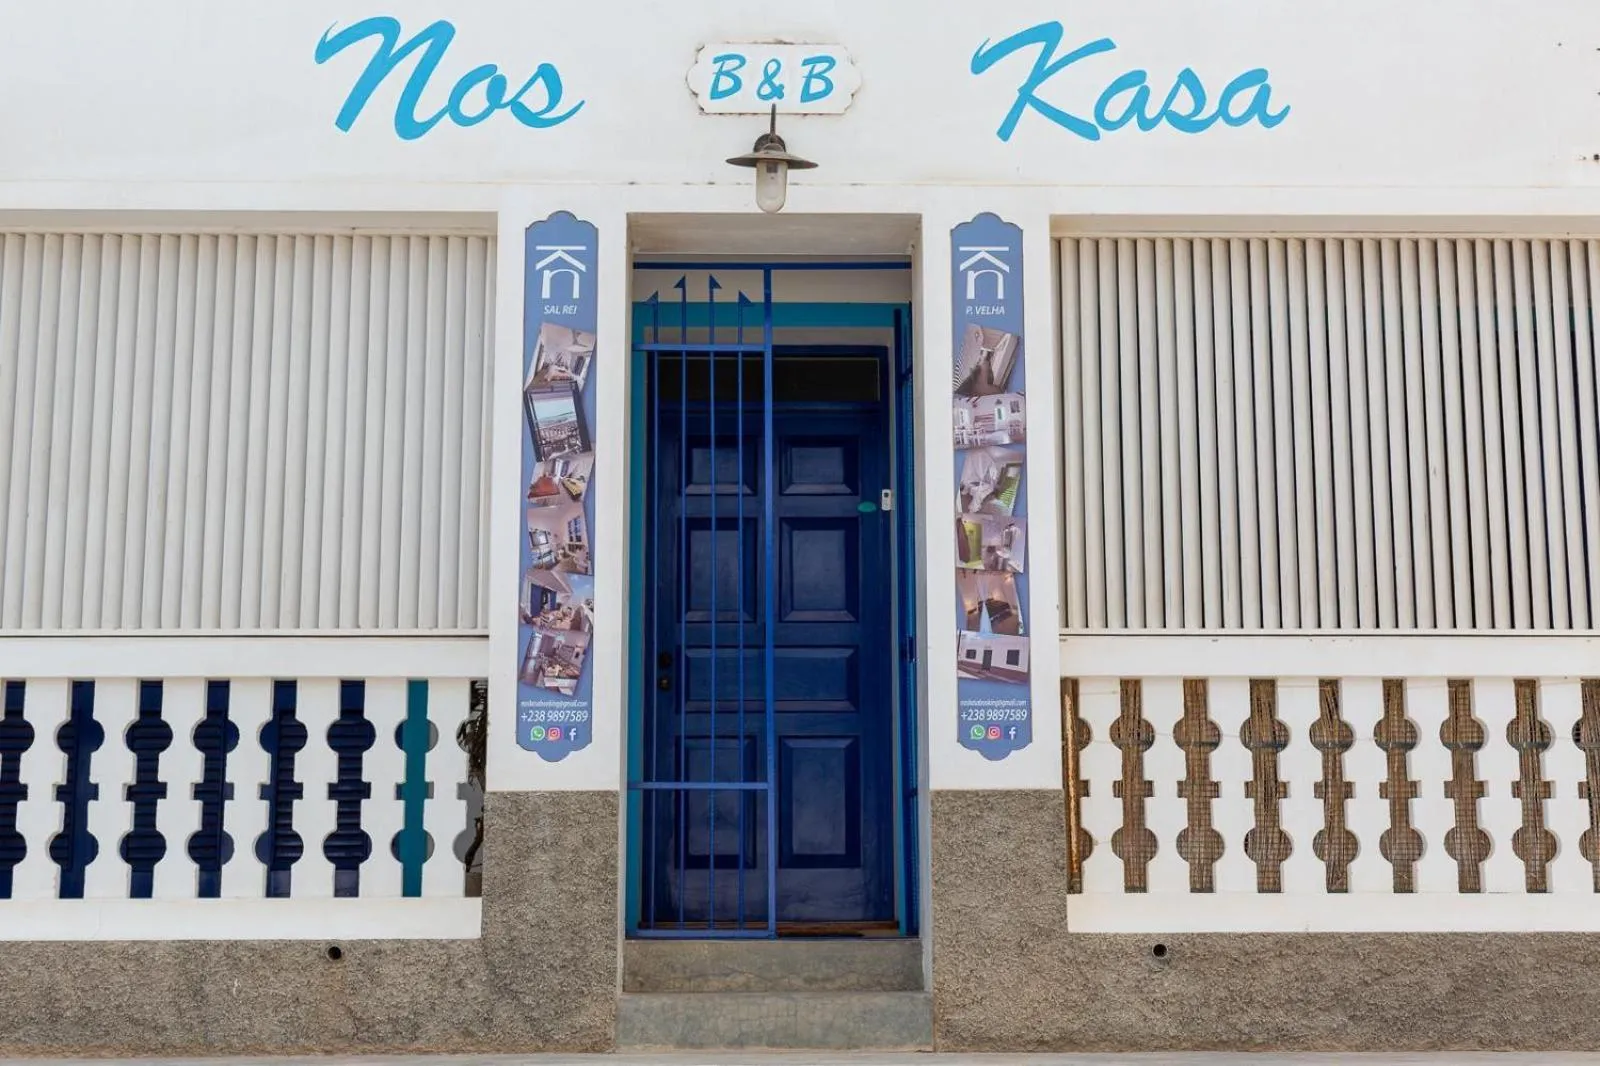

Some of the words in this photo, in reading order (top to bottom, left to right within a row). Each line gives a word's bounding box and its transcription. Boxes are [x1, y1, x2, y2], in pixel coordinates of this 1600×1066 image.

[314, 16, 585, 141] Nos
[970, 21, 1291, 142] Kasa
[709, 53, 747, 101] B
[756, 58, 786, 102] &
[800, 54, 837, 103] B
[543, 304, 560, 315] SAL
[562, 304, 578, 315] REI
[965, 305, 974, 316] P.
[975, 305, 1006, 316] VELHA
[520, 710, 546, 722] +238
[547, 710, 589, 722] 9897589
[960, 709, 985, 721] +238
[986, 709, 1028, 721] 9897589
